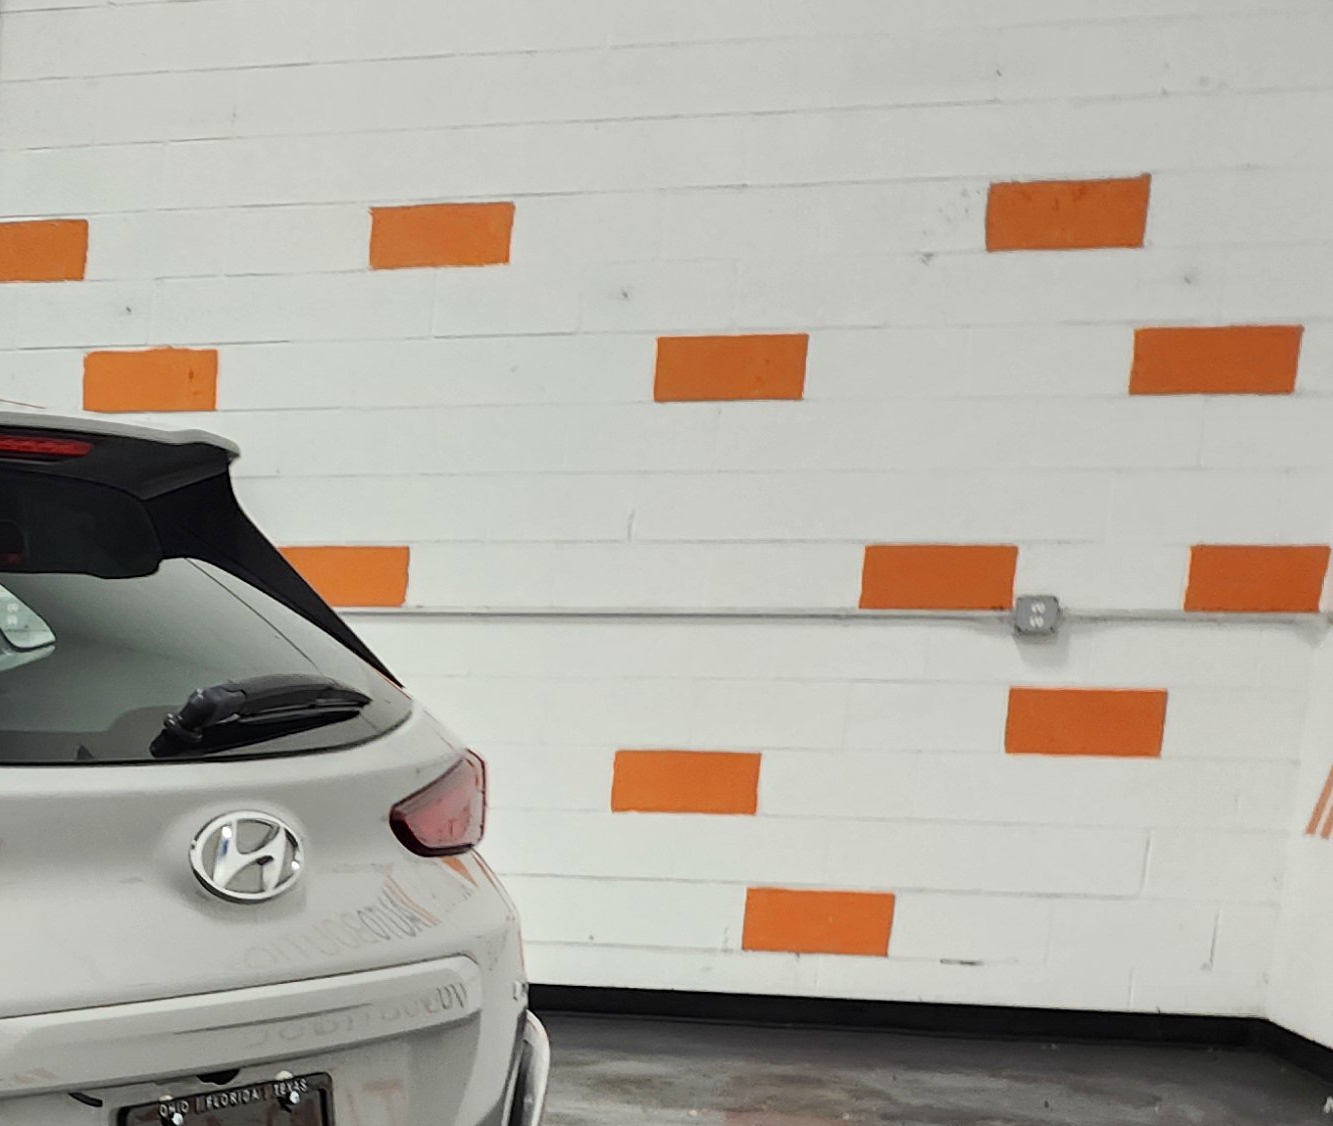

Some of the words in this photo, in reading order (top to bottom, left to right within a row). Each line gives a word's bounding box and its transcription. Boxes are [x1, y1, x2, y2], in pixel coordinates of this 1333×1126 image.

[159, 1100, 190, 1117] OHIO
[205, 1088, 260, 1109] FLORIDA
[274, 1077, 309, 1096] TEXAS
